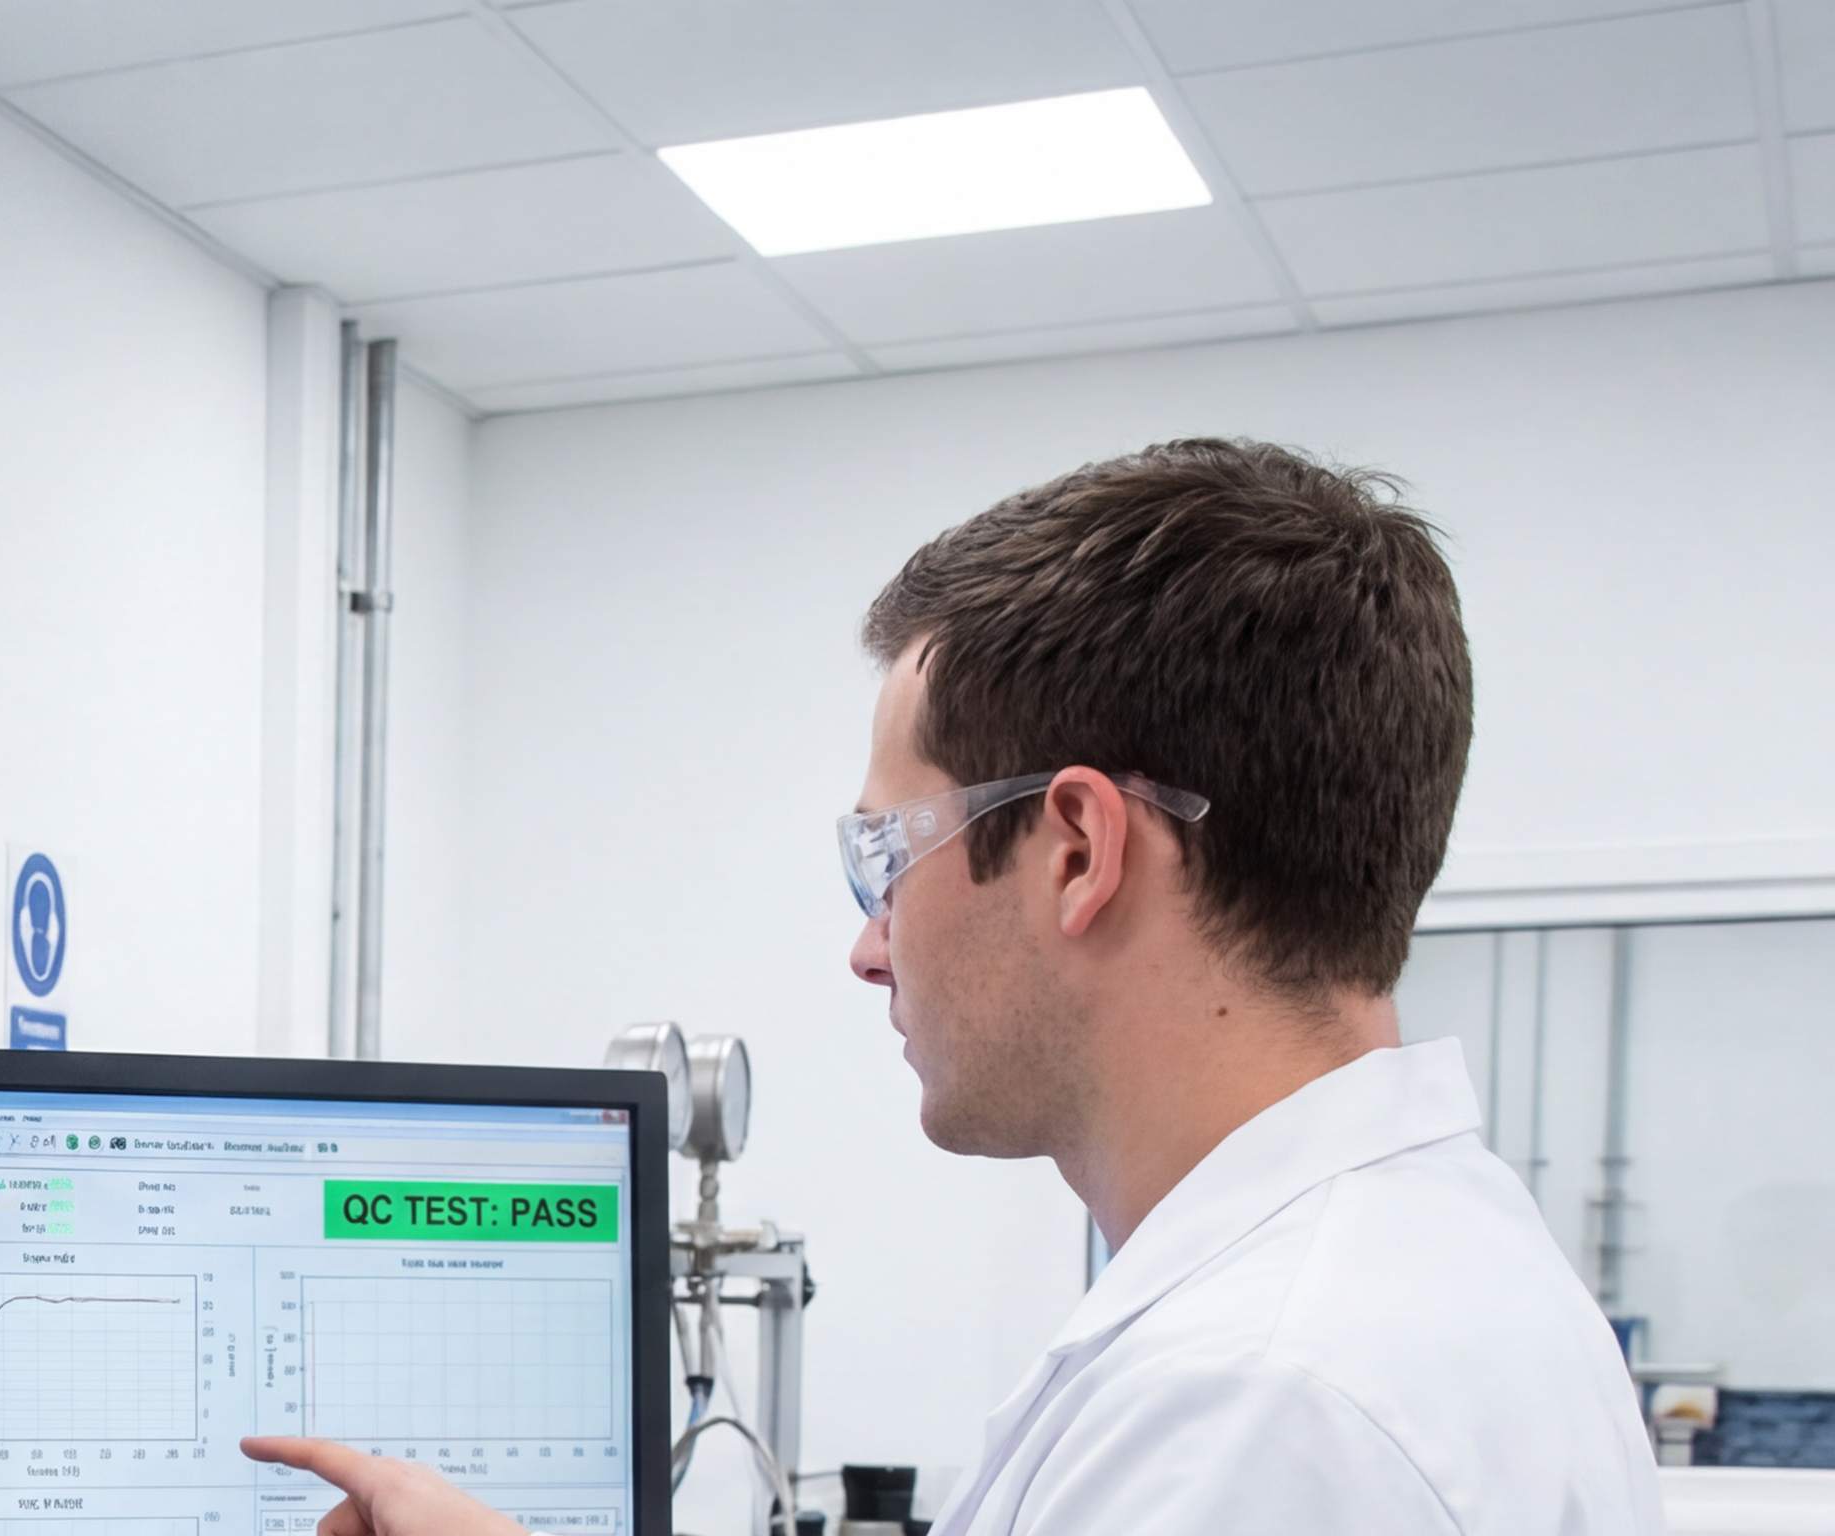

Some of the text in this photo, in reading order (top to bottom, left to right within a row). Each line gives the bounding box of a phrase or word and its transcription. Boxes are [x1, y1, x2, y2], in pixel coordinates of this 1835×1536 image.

[344, 1193, 598, 1229] QC TEST: PASS
